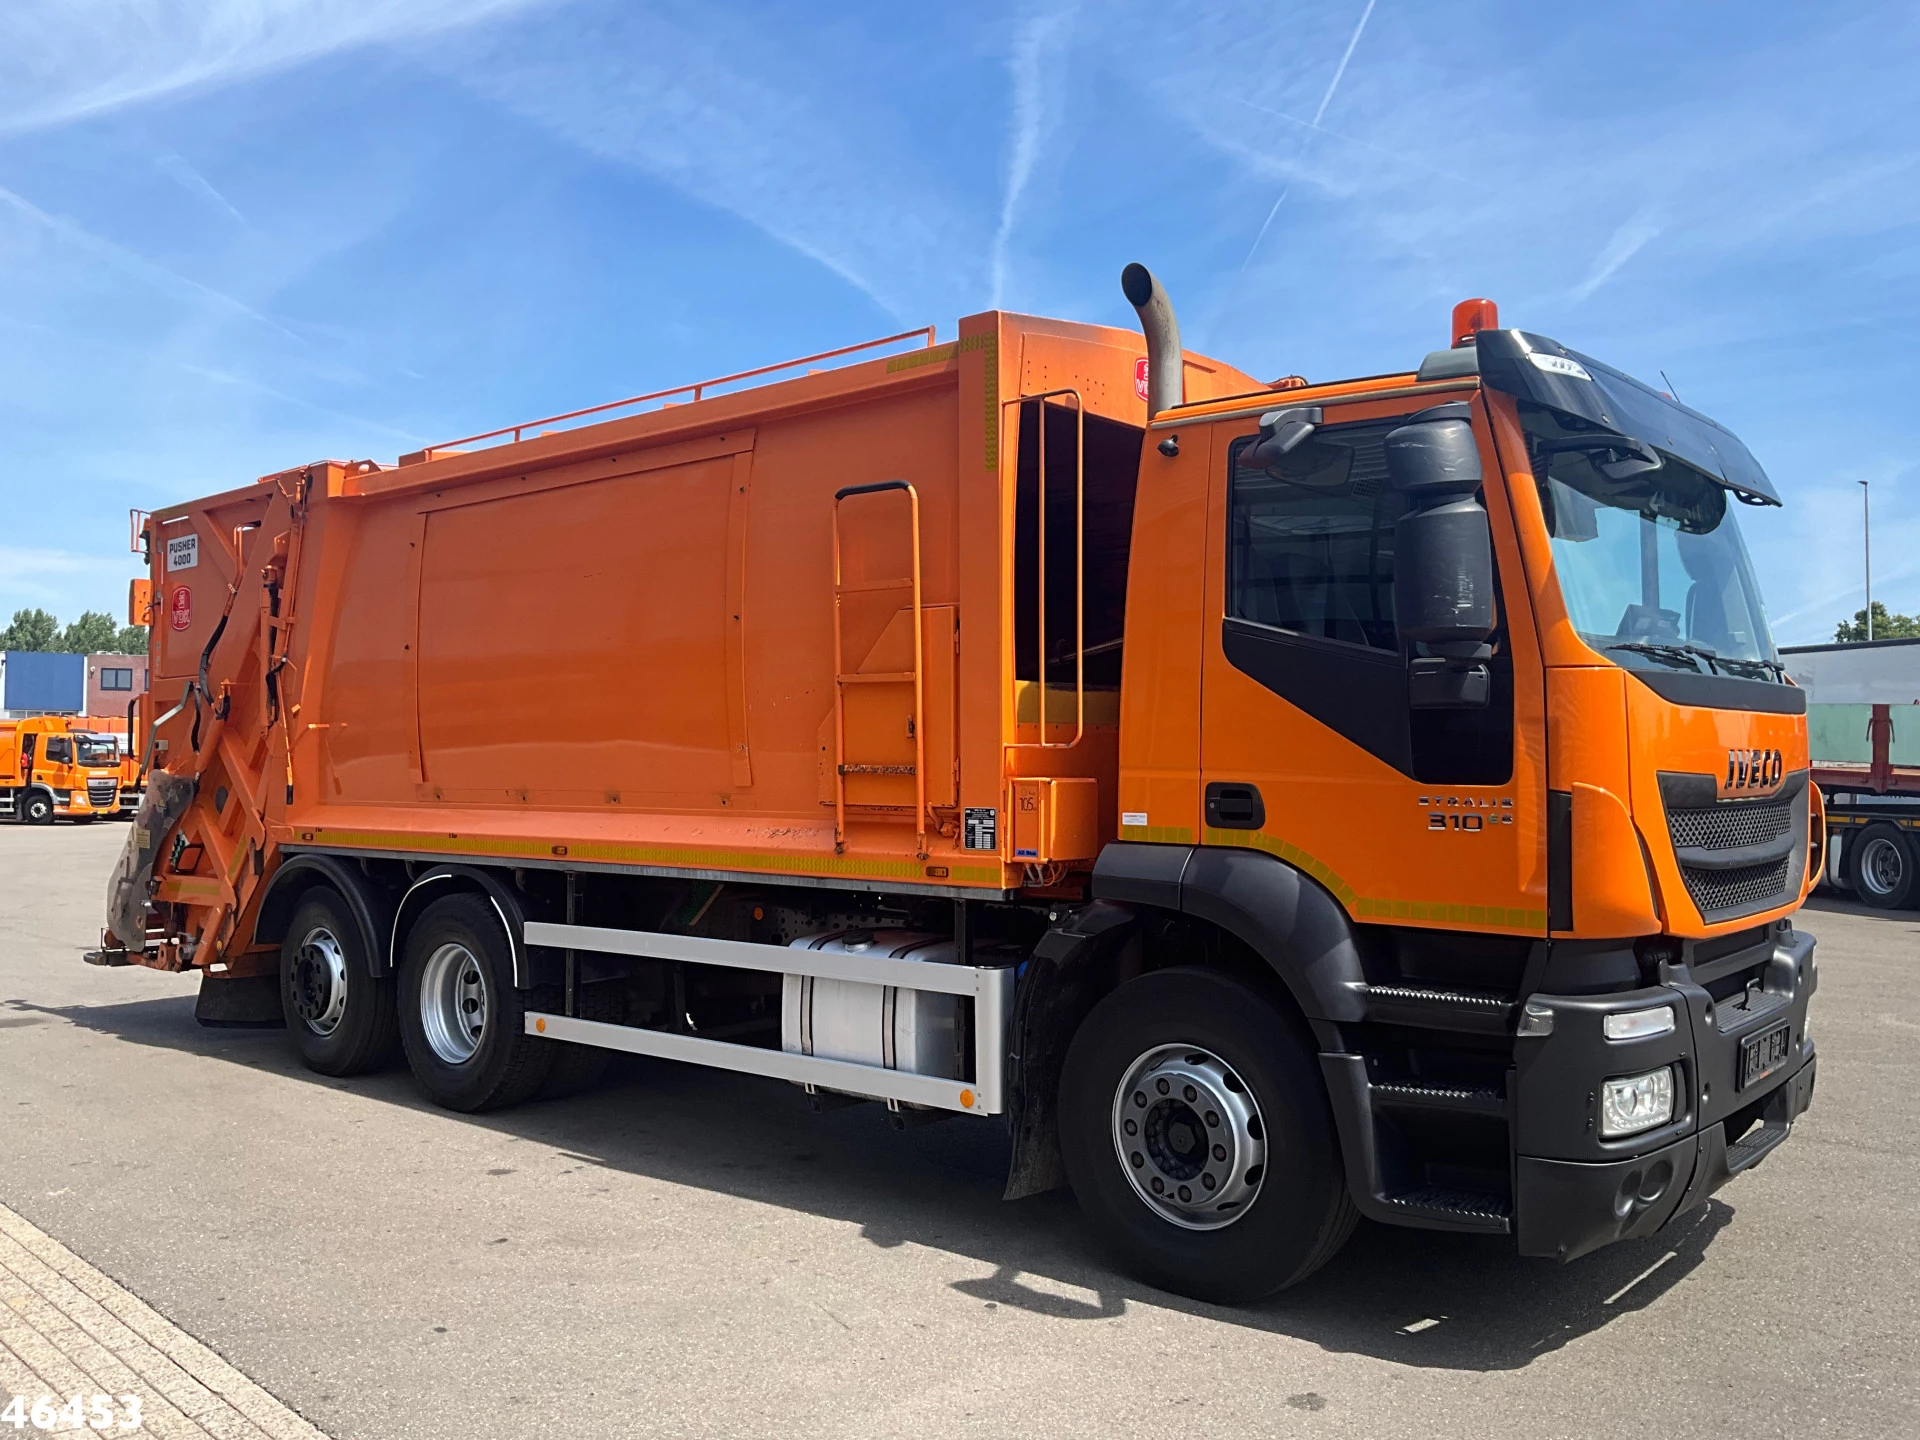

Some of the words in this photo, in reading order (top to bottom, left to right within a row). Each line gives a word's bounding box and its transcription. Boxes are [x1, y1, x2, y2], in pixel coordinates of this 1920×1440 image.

[169, 538, 196, 554] PUSHER
[173, 553, 191, 566] 4000
[1725, 749, 1782, 789] IVECO
[1418, 796, 1513, 808] STRALIS
[1428, 812, 1483, 832] 310
